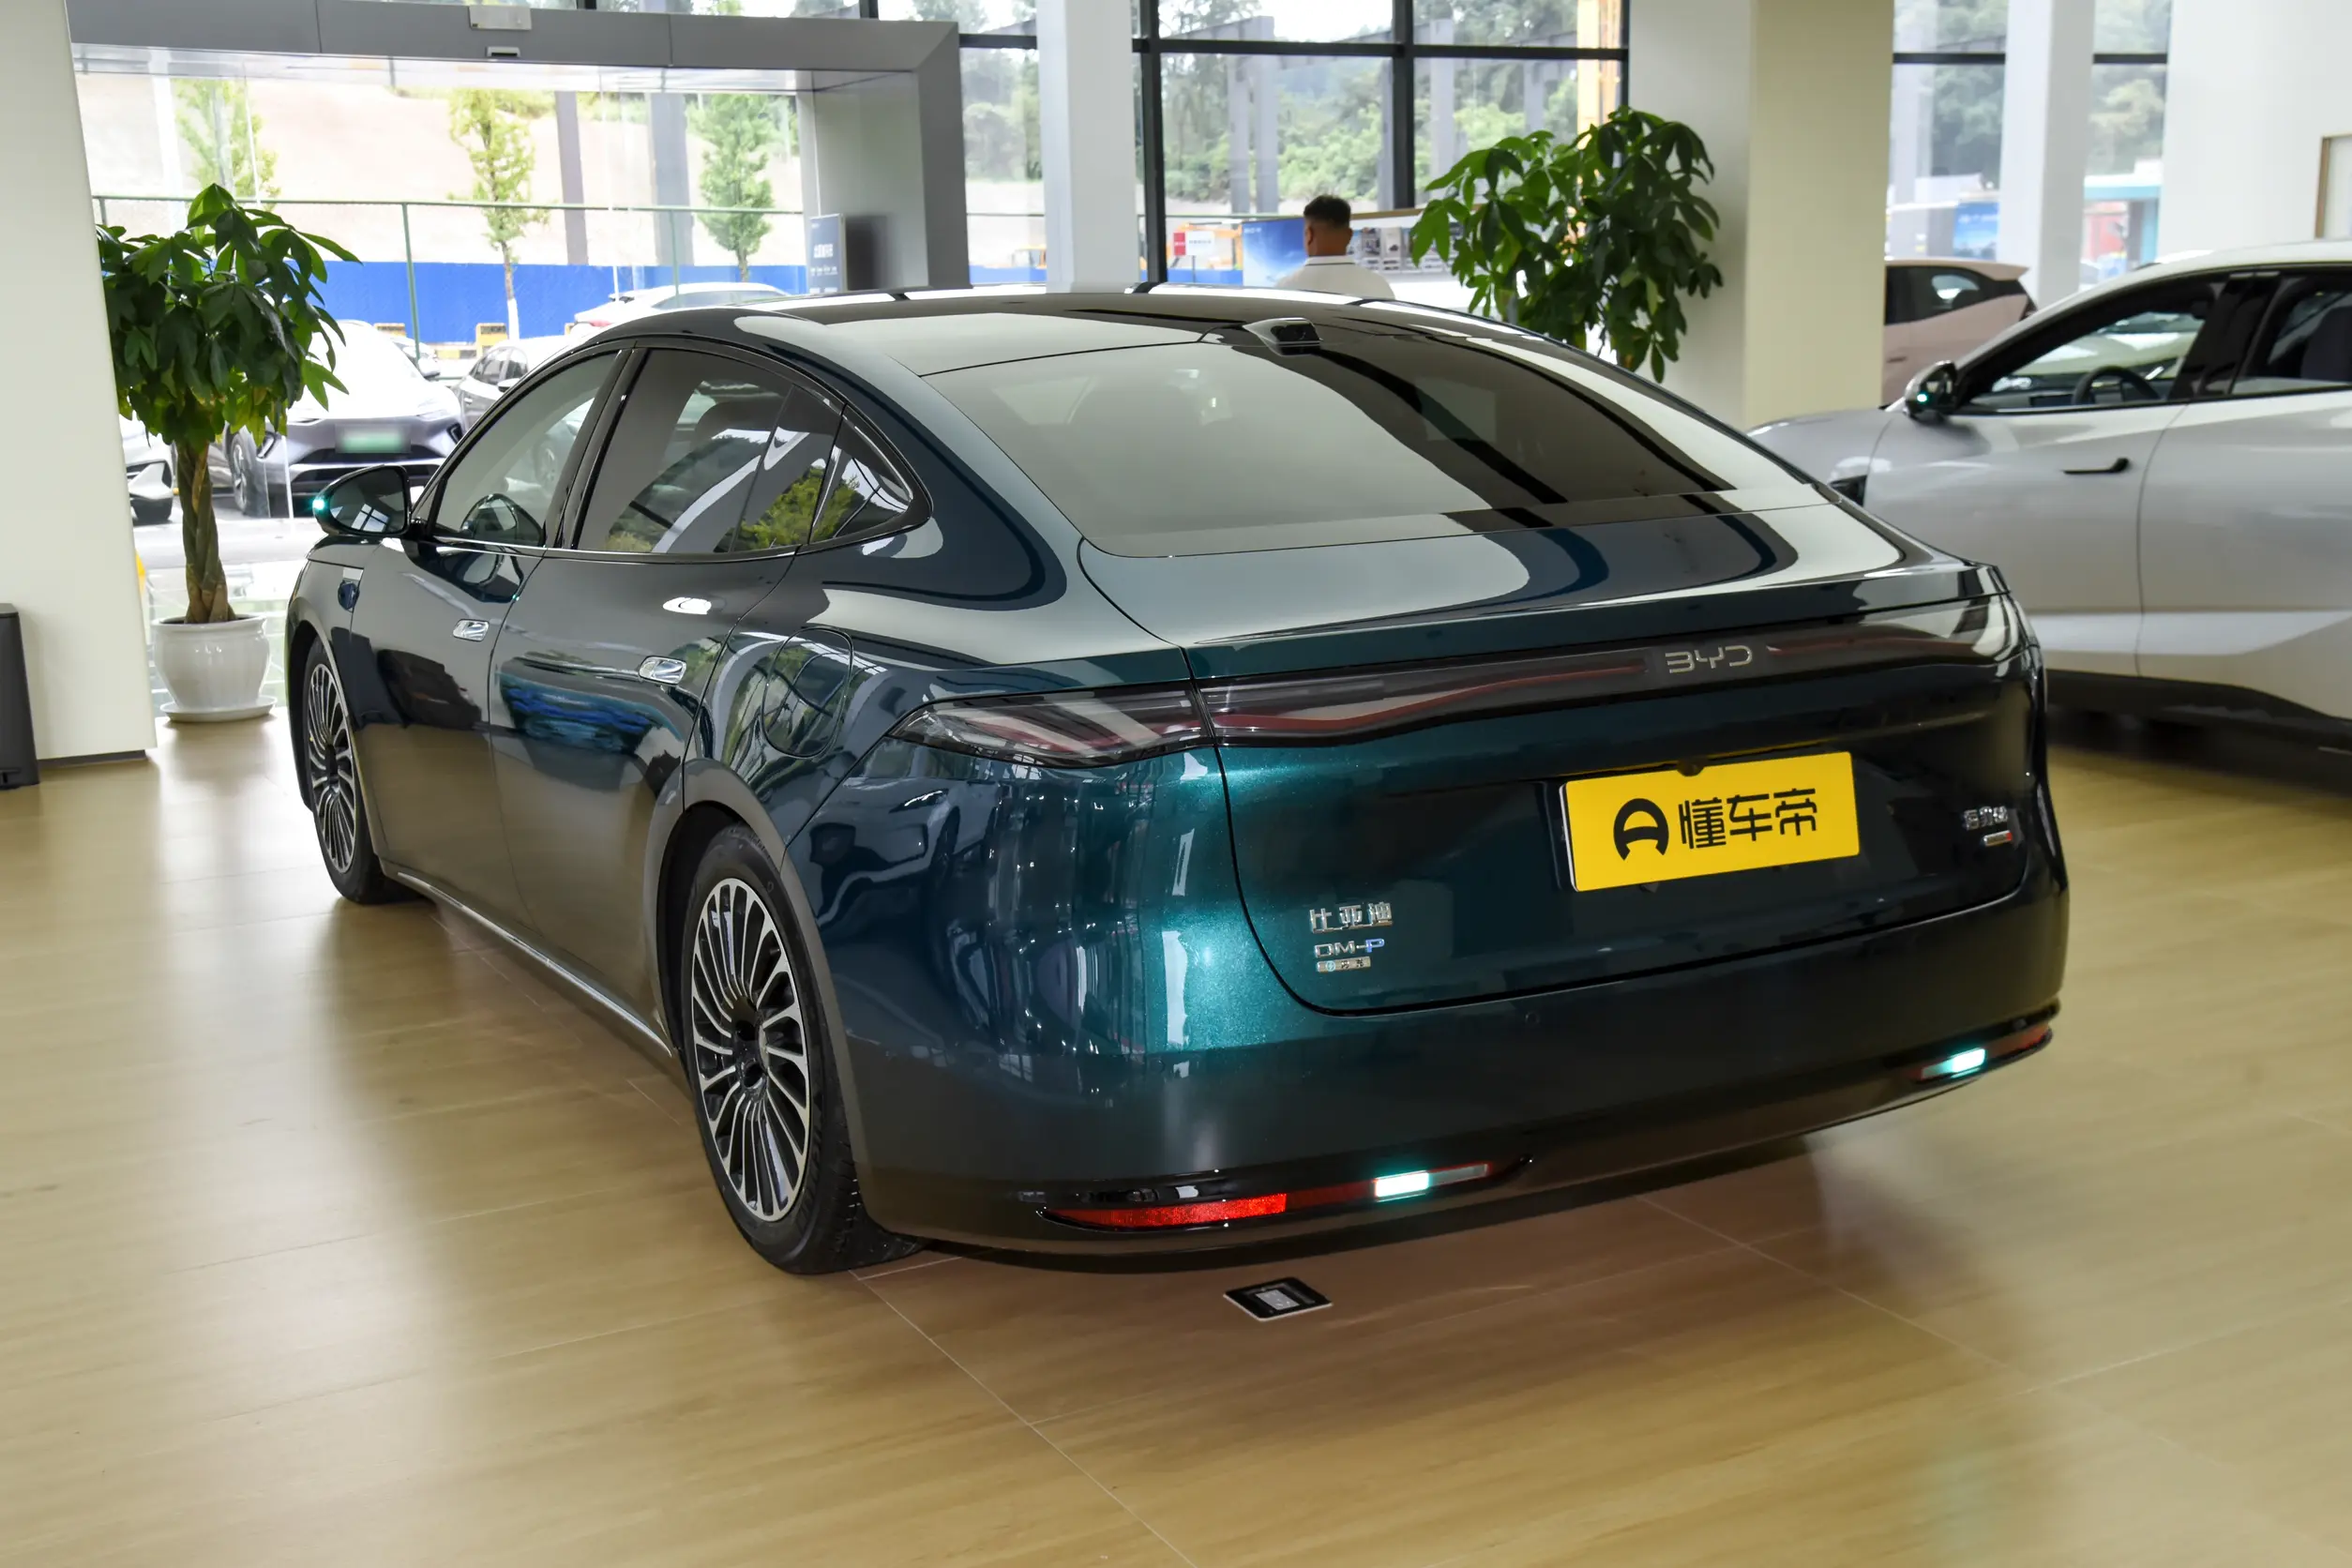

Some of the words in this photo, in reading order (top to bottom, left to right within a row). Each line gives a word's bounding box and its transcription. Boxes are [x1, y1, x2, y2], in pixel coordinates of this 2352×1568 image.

[1665, 644, 1753, 673] BYD
[1678, 787, 1817, 849] 懂车帝
[1309, 901, 1393, 933] 比亚迪
